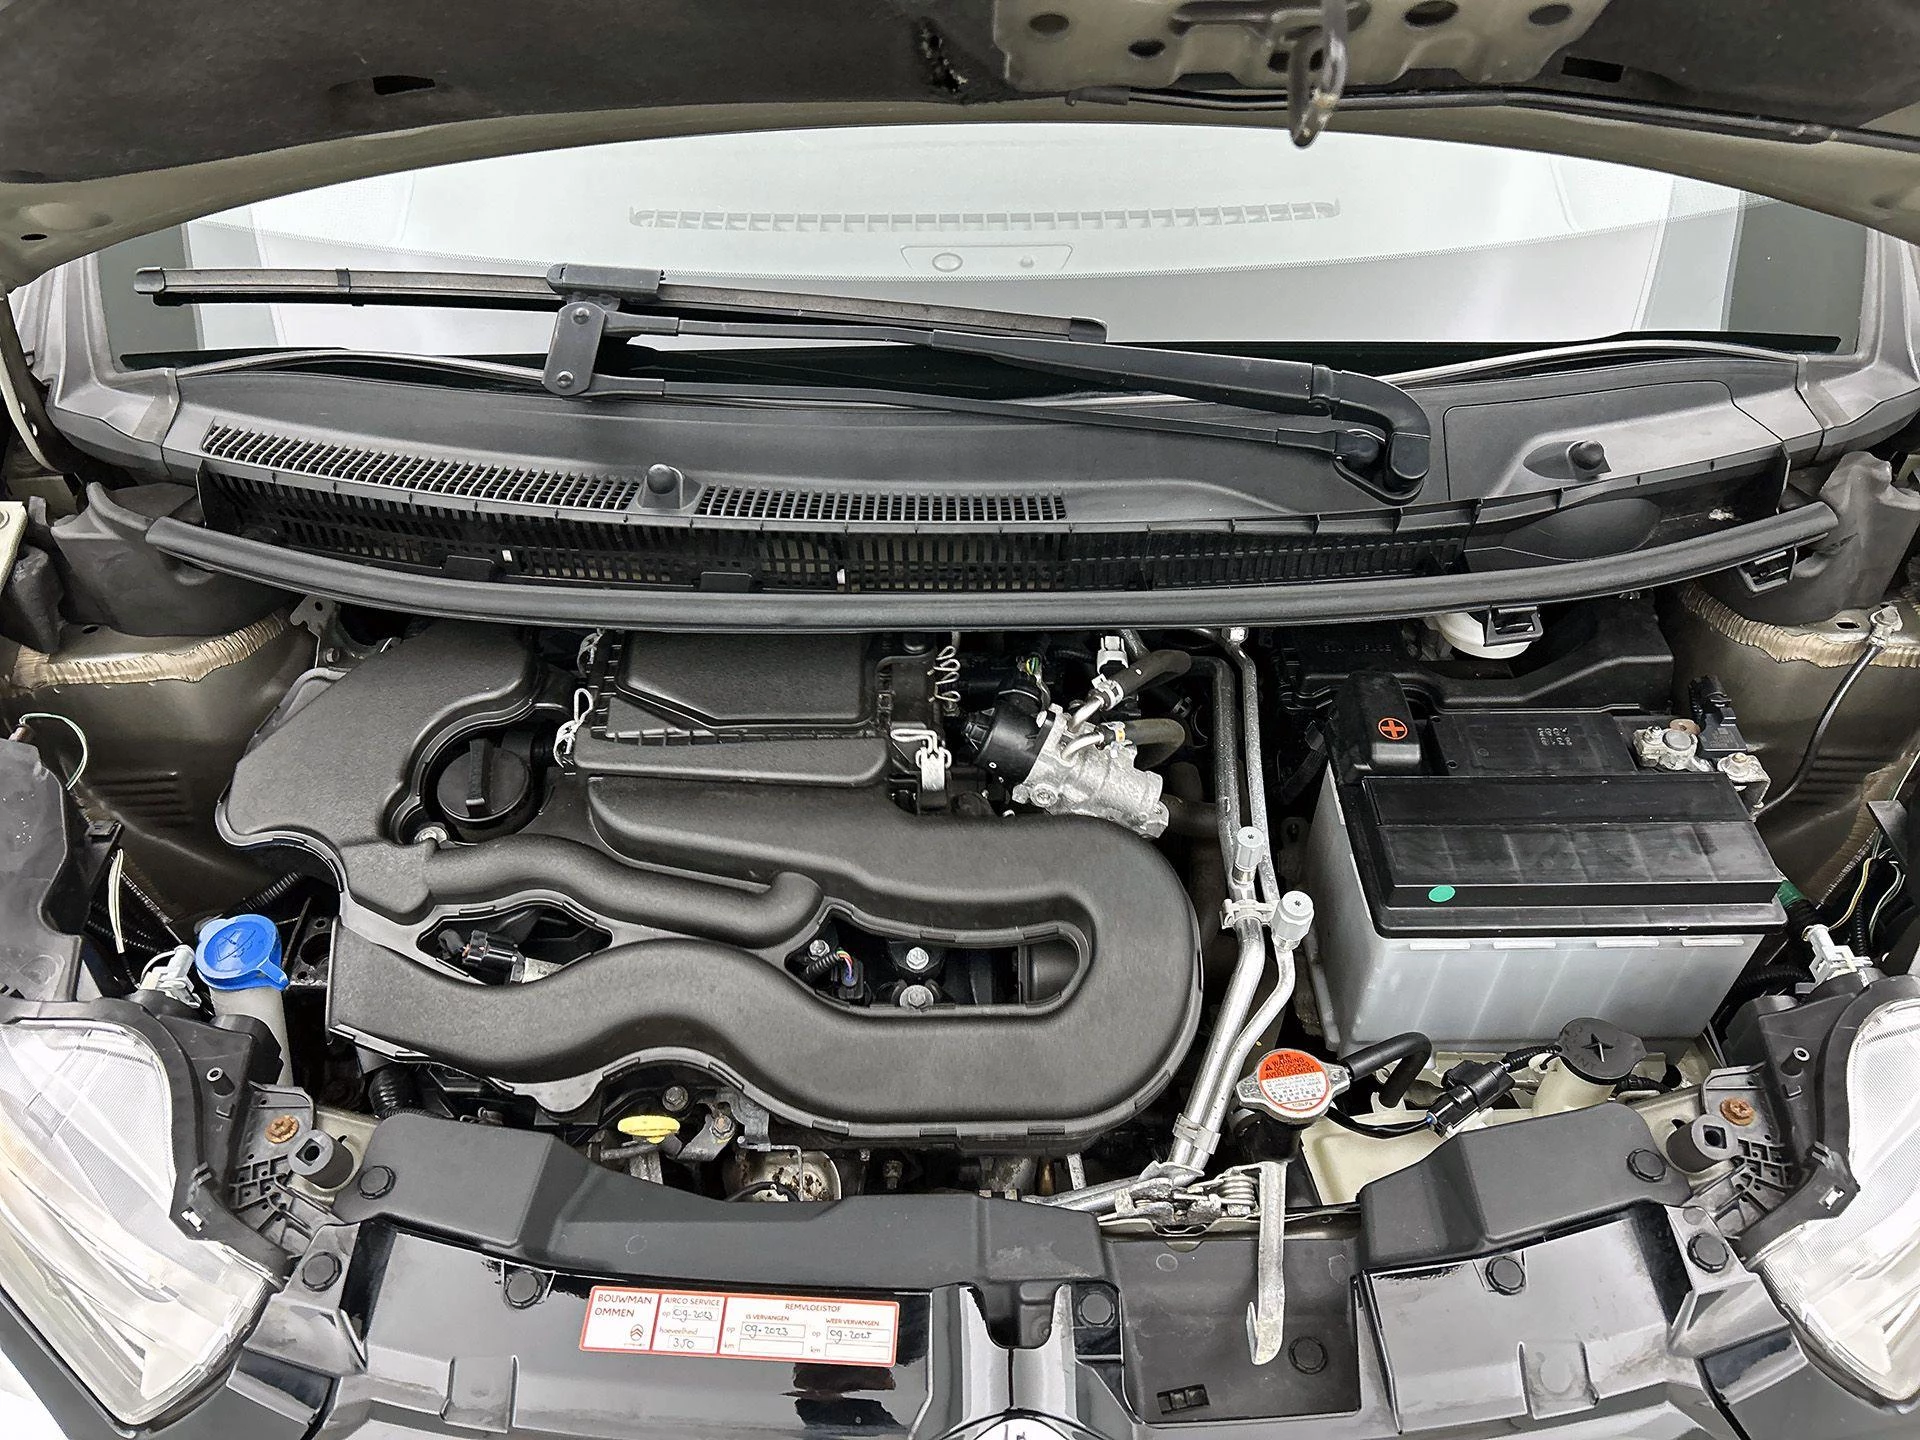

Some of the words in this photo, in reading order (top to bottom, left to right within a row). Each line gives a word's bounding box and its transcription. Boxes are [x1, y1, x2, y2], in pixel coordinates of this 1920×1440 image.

[597, 1293, 653, 1304] BOUWMAN
[664, 1297, 688, 1305] AIRCO
[689, 1298, 720, 1306] SERVICE
[594, 1307, 635, 1317] OMMEN
[785, 1303, 842, 1312] REMVLOEISTOF
[843, 1319, 880, 1327] VERVANGEN
[811, 1330, 821, 1338] op
[673, 1338, 695, 1349] 350
[724, 1341, 735, 1349] km
